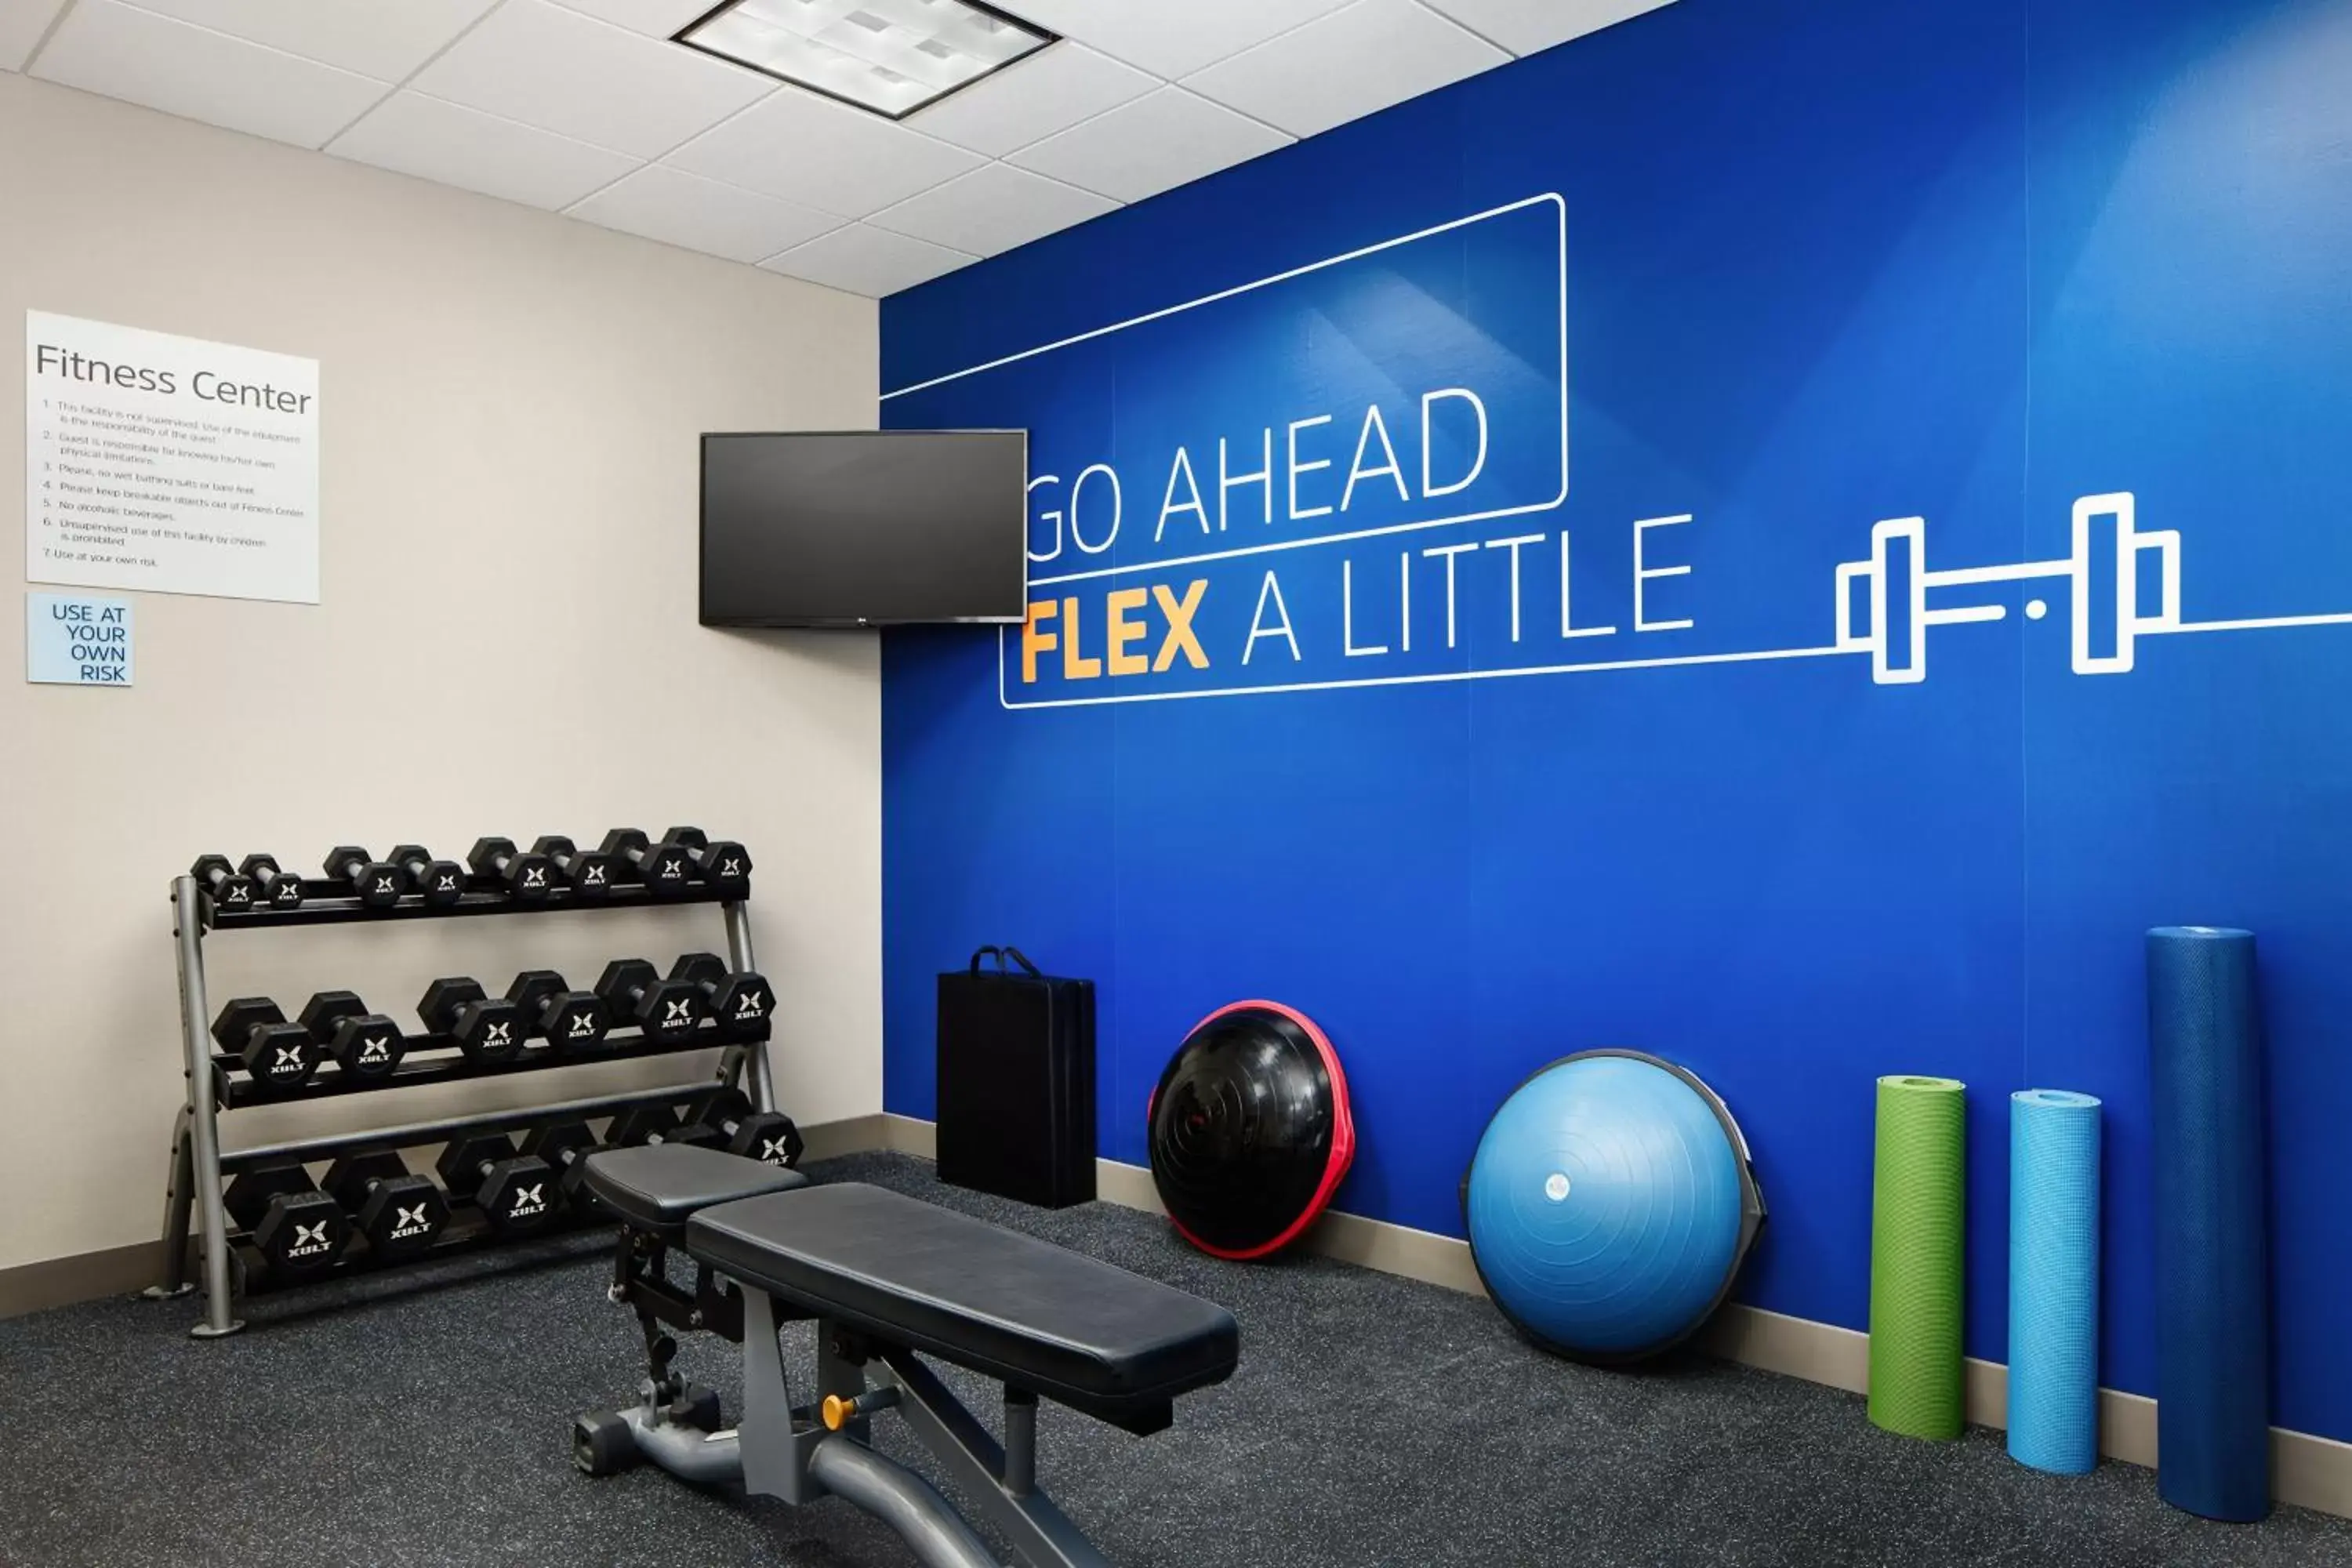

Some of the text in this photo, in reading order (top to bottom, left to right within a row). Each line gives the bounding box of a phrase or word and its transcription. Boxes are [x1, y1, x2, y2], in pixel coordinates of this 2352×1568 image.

[37, 343, 311, 414] Fitness Center
[1027, 387, 1488, 562] GO AHEAD
[1022, 514, 1694, 683] FLEX A LITTLE
[53, 604, 125, 623] USE AT
[66, 625, 125, 643] YOUR
[71, 644, 125, 662] OWN
[81, 664, 125, 681] RISK
[510, 1204, 545, 1217] XULT
[391, 1223, 430, 1239] XULT
[289, 1242, 331, 1258] XULT
